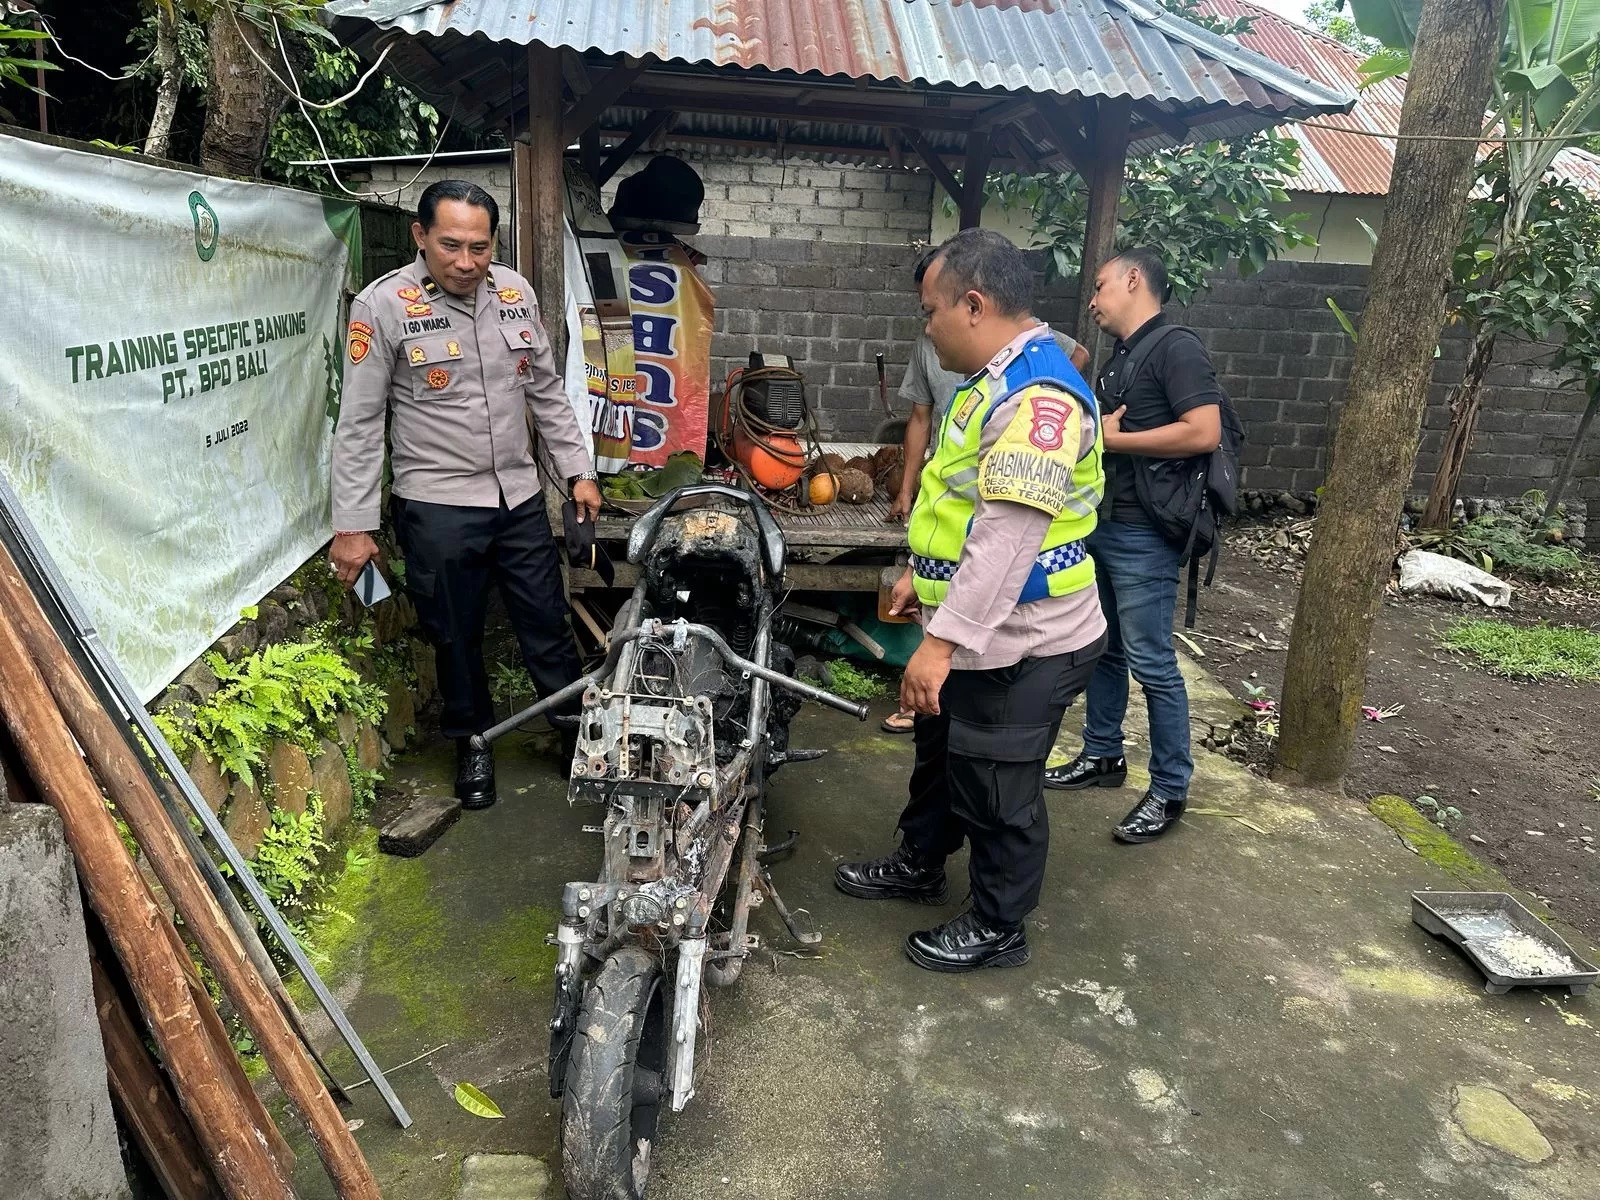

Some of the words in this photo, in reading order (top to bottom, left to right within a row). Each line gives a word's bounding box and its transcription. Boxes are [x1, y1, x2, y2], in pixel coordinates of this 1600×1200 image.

[499, 307, 532, 321] POLRI
[402, 322, 408, 336] I
[420, 316, 452, 332] WIARSA
[65, 331, 179, 384] TRAINING
[183, 320, 252, 361] SPECIFIC
[254, 311, 306, 345] BANKING
[161, 368, 194, 404] PT.
[198, 357, 231, 393] BPD
[235, 349, 269, 382] BALI
[205, 434, 212, 449] 5
[214, 427, 230, 446] JULI
[230, 419, 249, 438] 2022
[984, 478, 1015, 487] DESA
[986, 486, 1012, 495] KEC.
